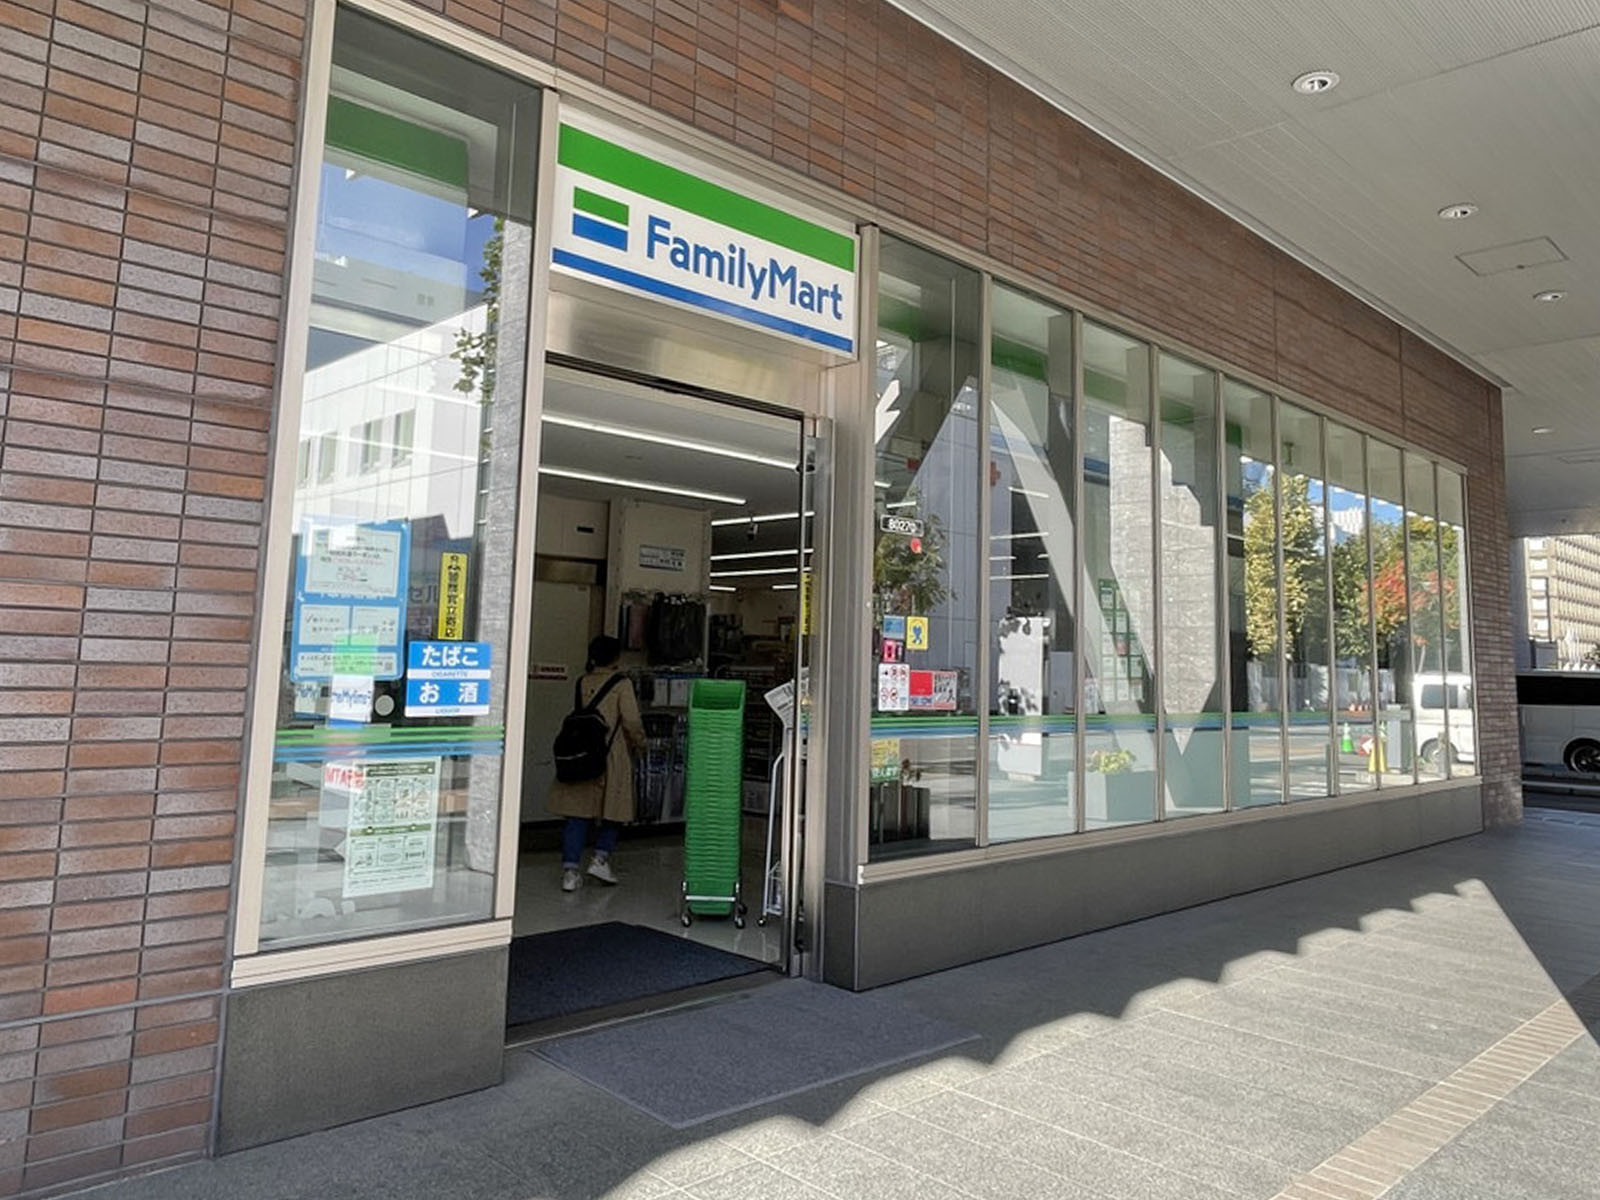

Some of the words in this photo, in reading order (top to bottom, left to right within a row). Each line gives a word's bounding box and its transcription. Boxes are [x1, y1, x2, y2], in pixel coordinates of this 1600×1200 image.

[646, 213, 843, 321] FamilyMart
[421, 645, 479, 667] たばこ
